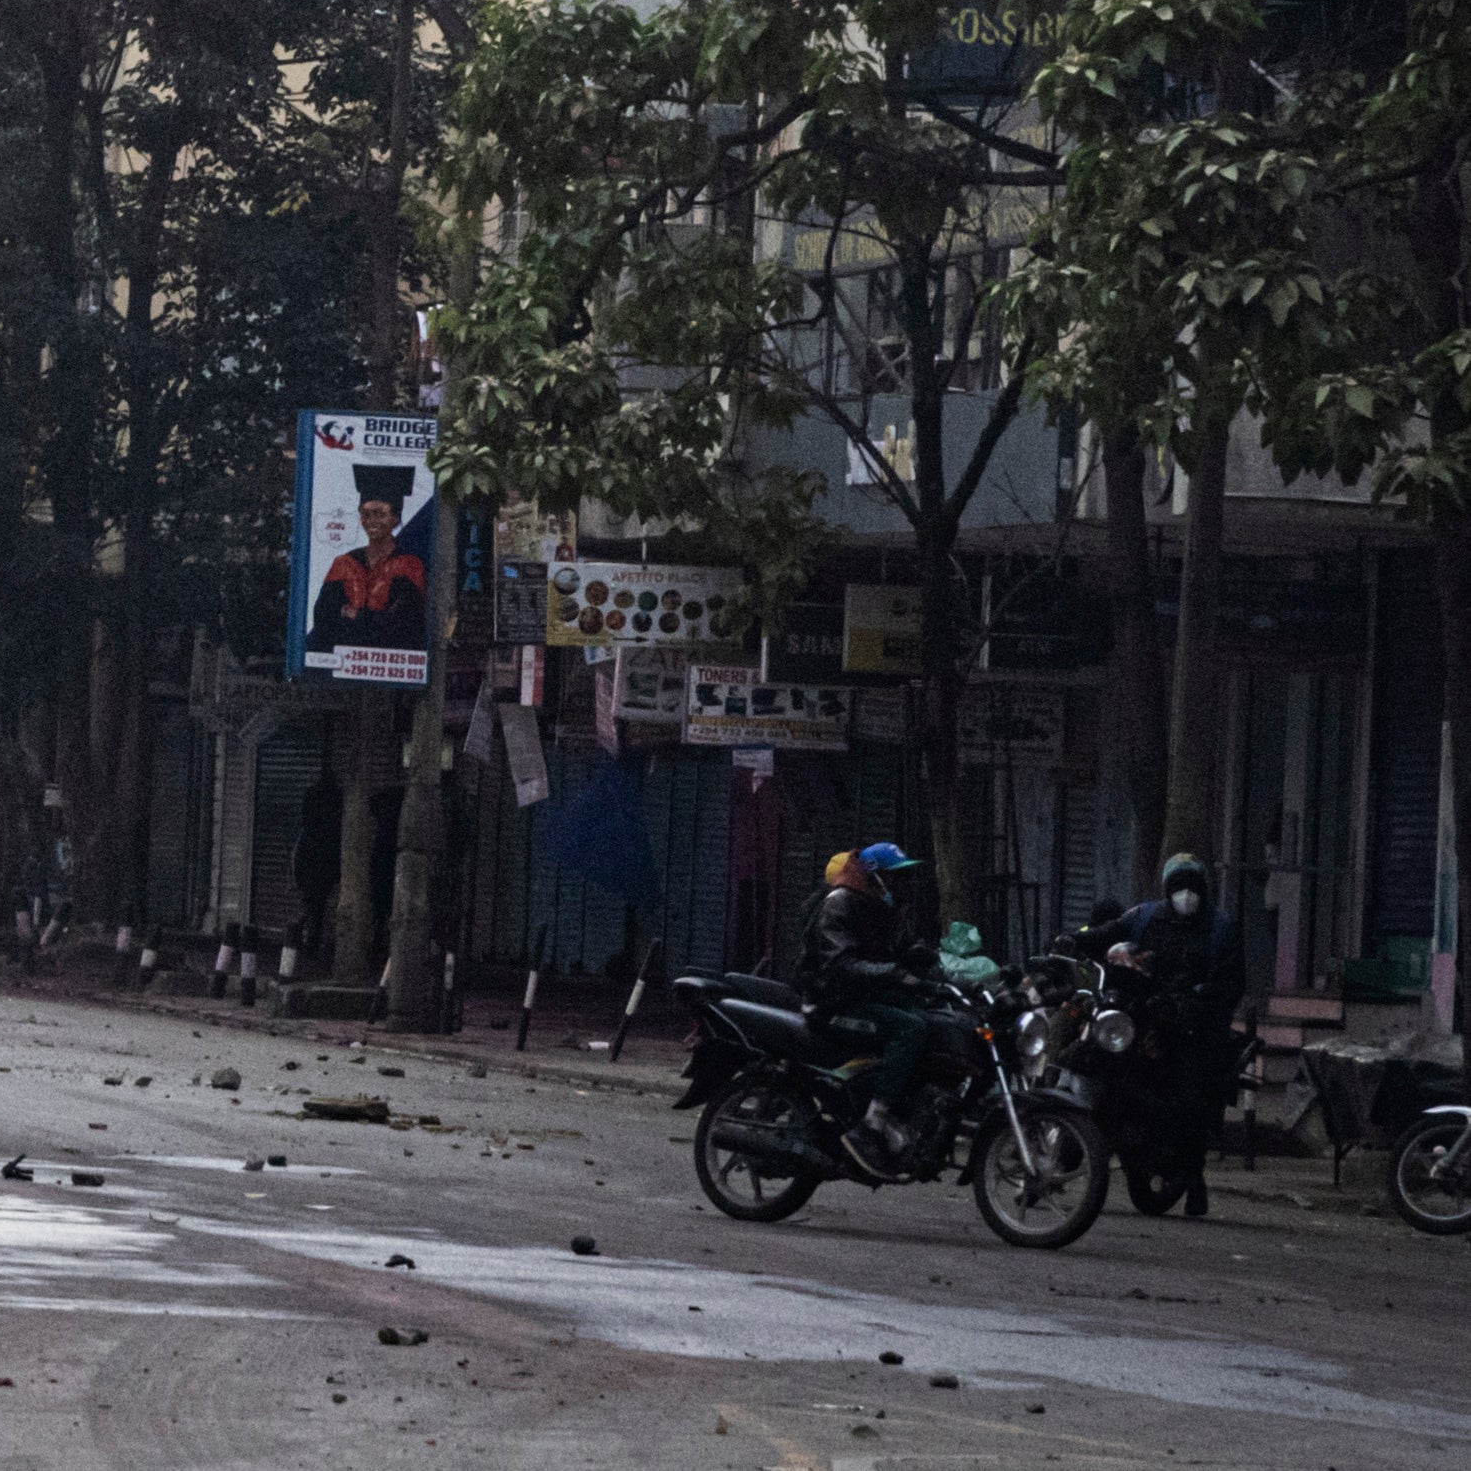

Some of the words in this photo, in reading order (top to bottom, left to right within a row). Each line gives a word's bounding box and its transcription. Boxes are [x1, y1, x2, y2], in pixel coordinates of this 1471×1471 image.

[365, 418, 437, 435] BRIDGE
[363, 433, 436, 449] COLLEGE
[699, 668, 747, 684] TONERS
